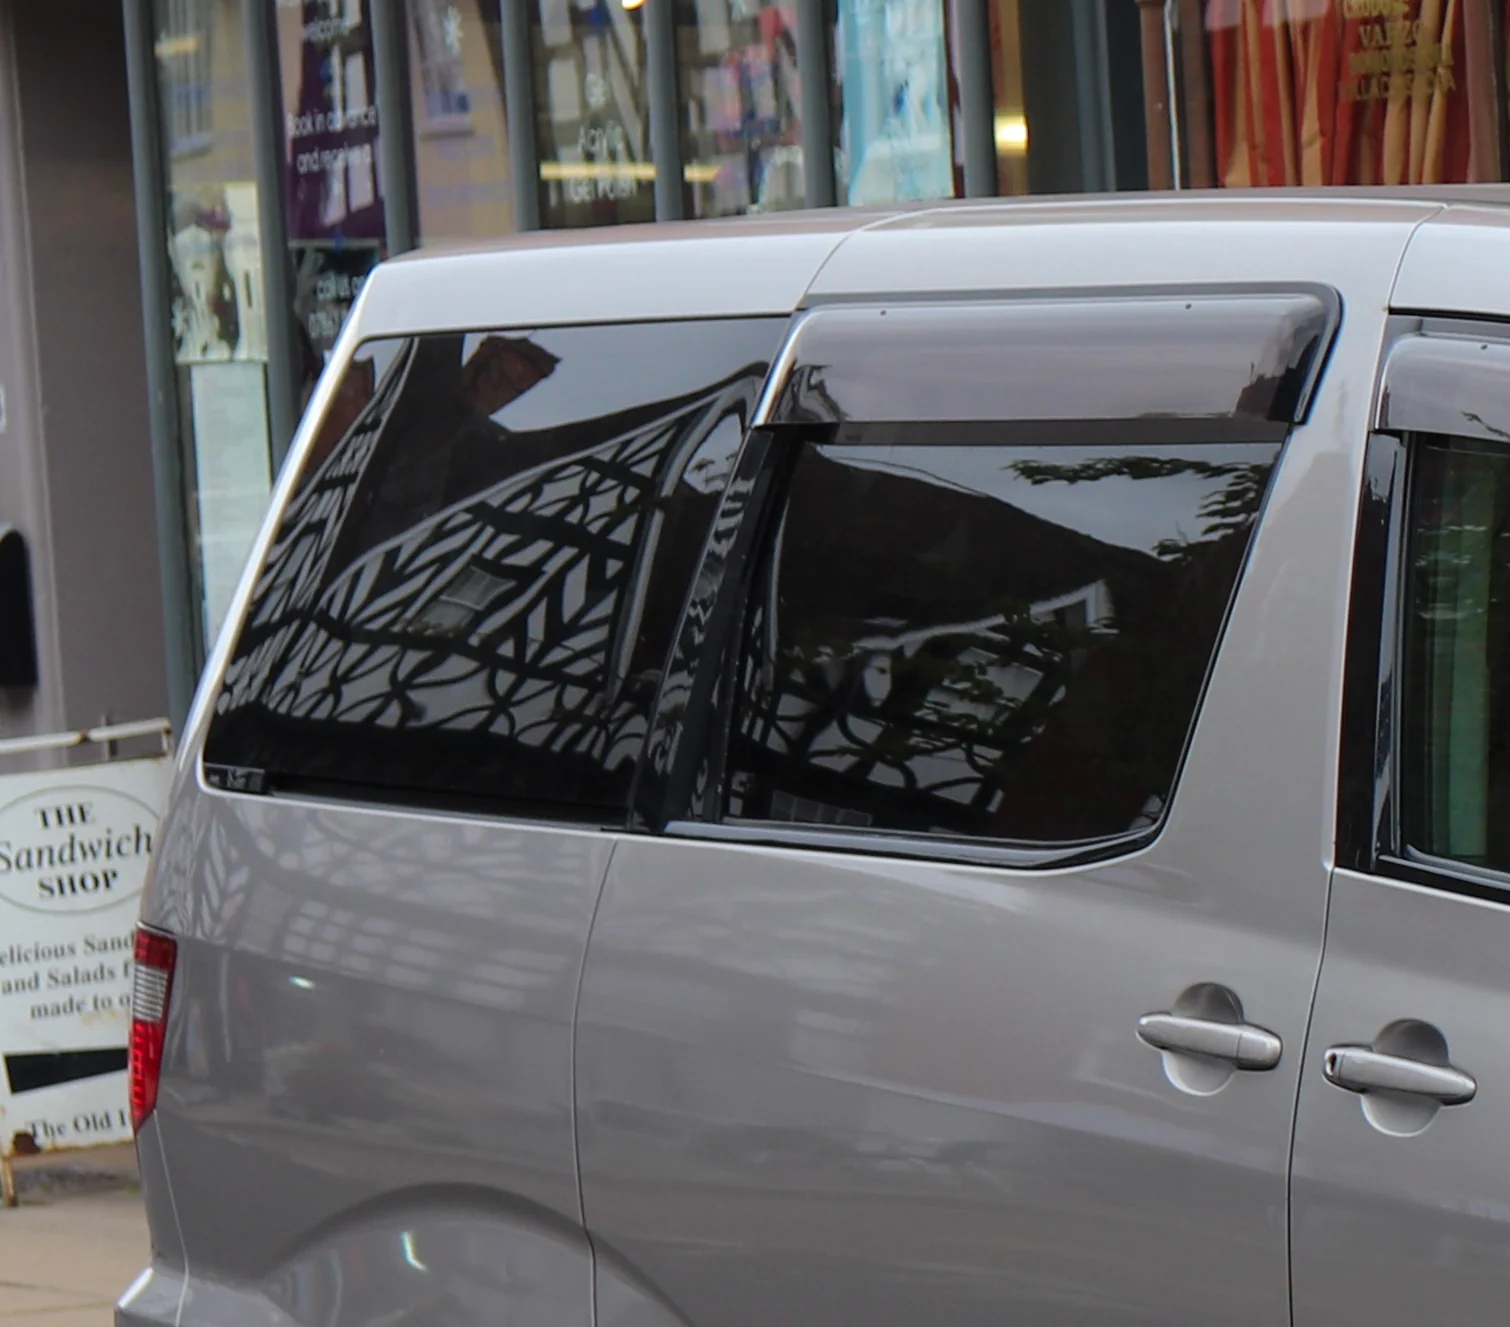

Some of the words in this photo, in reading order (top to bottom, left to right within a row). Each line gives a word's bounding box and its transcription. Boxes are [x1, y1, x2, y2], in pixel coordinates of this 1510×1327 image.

[34, 802, 95, 829] THE
[0, 824, 153, 874] Sandwich
[38, 869, 119, 900] SHOP
[47, 960, 116, 989] Salads
[30, 994, 86, 1019] made
[93, 993, 113, 1011] to
[73, 1108, 112, 1132] Old
